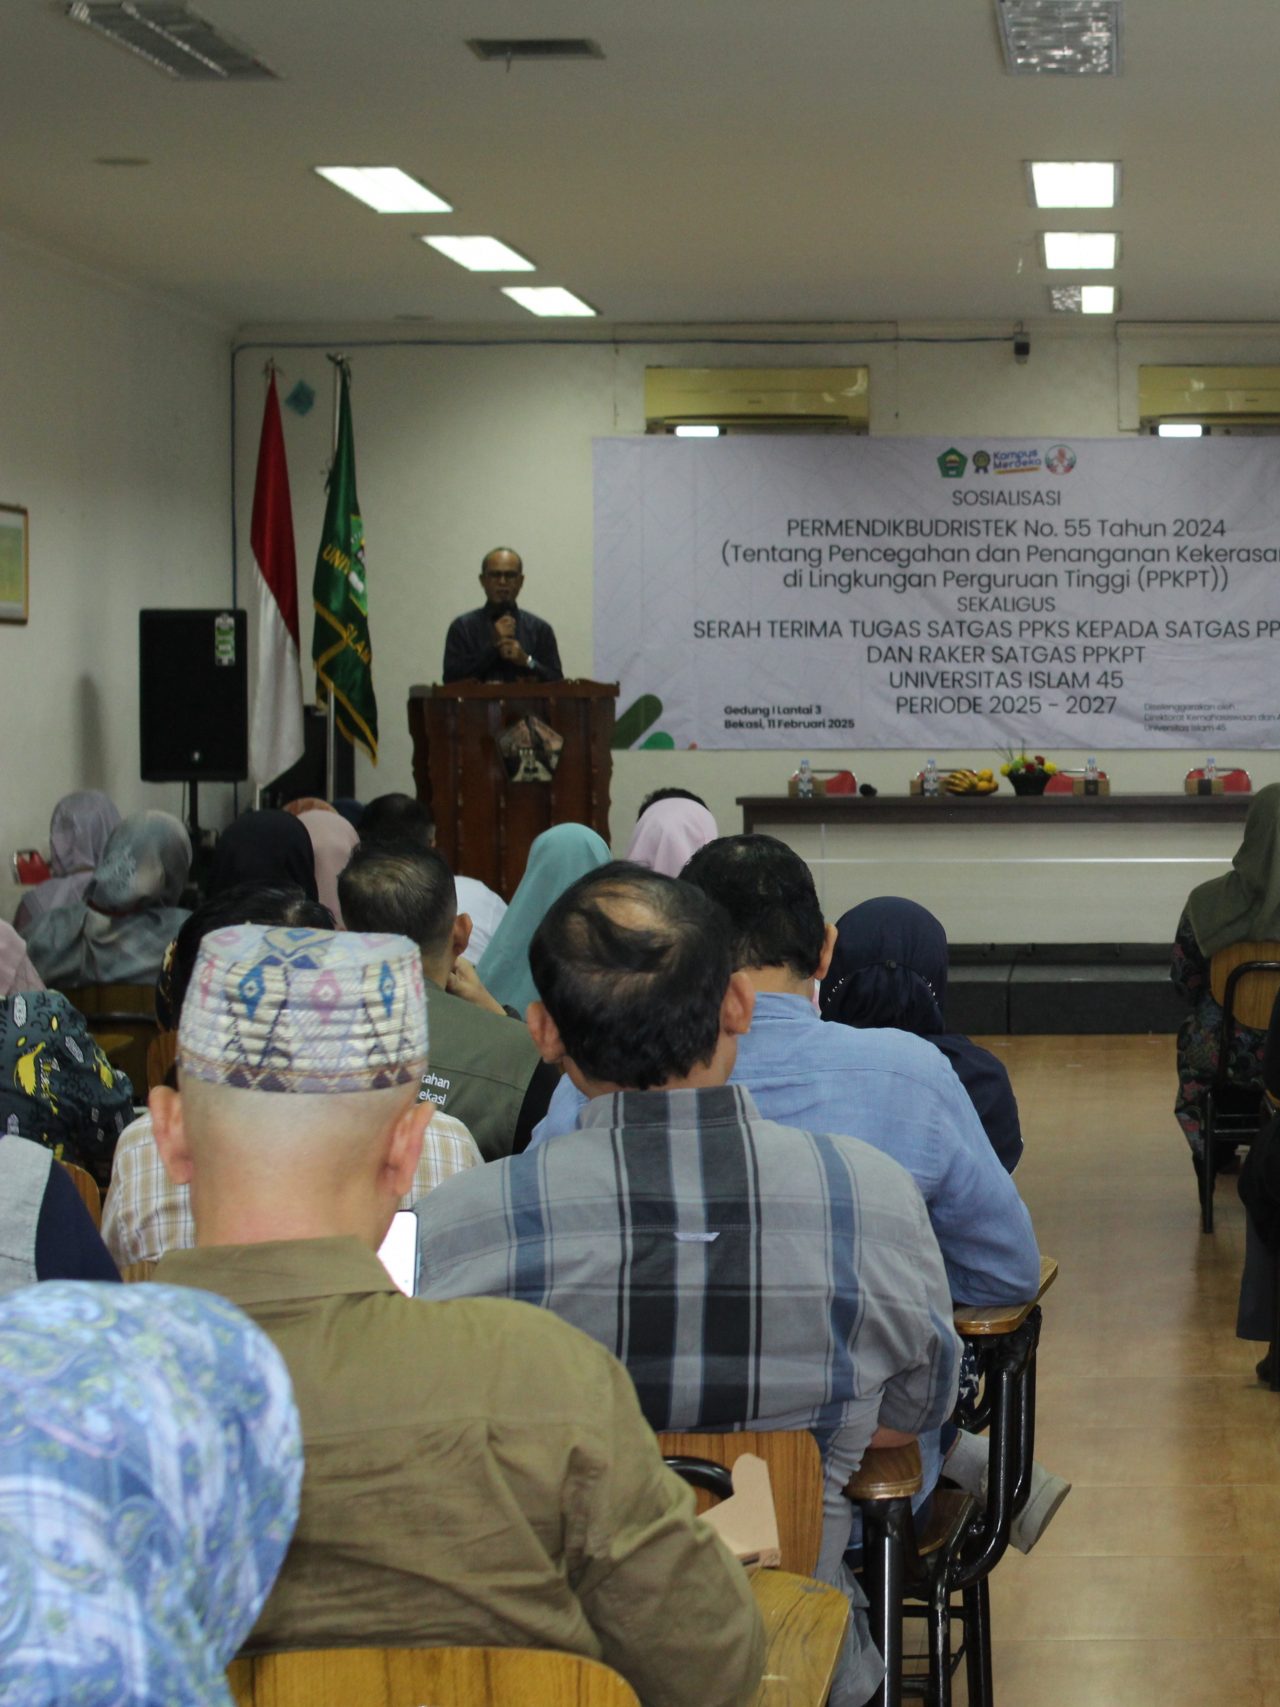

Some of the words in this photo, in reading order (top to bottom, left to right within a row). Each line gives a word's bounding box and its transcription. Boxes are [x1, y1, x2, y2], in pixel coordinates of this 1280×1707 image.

[993, 449, 1038, 461] Kampus
[993, 458, 1042, 470] Merdeka
[952, 489, 1061, 506] SOSIALISASI
[787, 518, 1017, 538] PERMENDIKBUDRISTEK
[1025, 519, 1058, 538] No.
[1065, 519, 1092, 538] 55
[1098, 518, 1167, 538] Tahun
[1173, 518, 1227, 538] 2024
[721, 540, 823, 568] (Tentang
[828, 544, 970, 568] Pencegahan
[975, 543, 1021, 563] dan
[1026, 544, 1170, 568] Penanganan
[783, 569, 803, 588] di
[809, 569, 936, 594] Lingkungan
[943, 569, 1058, 594] Perguruan
[1064, 569, 1131, 594] Tinggi
[1137, 565, 1229, 593] (PPKPT))
[957, 596, 1056, 613] SEKALIGUS
[693, 619, 761, 639] SERAH
[767, 619, 843, 639] TERIMA
[849, 619, 921, 639] TUGAS
[927, 619, 1013, 639] SATGAS
[1018, 620, 1070, 639] PPKS
[1076, 620, 1160, 639] KEPADA
[1165, 619, 1251, 639] SATGAS
[866, 645, 913, 664] DAN
[919, 645, 986, 664] RAKER
[991, 645, 1077, 664] SATGAS
[1082, 645, 1146, 664] PPKPT
[889, 670, 1023, 689] UNIVERSITAS
[1028, 670, 1090, 689] ISLAM
[1096, 670, 1124, 689] 45
[723, 705, 770, 718] Gedung
[777, 705, 813, 715] Lantai
[815, 705, 822, 715] 3
[895, 695, 984, 715] PERIODE
[988, 695, 1042, 715] 2025
[1065, 695, 1118, 715] 2027
[724, 719, 765, 730] Bekasi,
[767, 719, 776, 729] 11
[778, 718, 826, 729] Februari
[828, 719, 855, 729] 2025
[1144, 713, 1184, 722] Direktorat
[1258, 713, 1275, 721] dan
[1144, 723, 1189, 732] Universitas
[1216, 723, 1226, 732] 45
